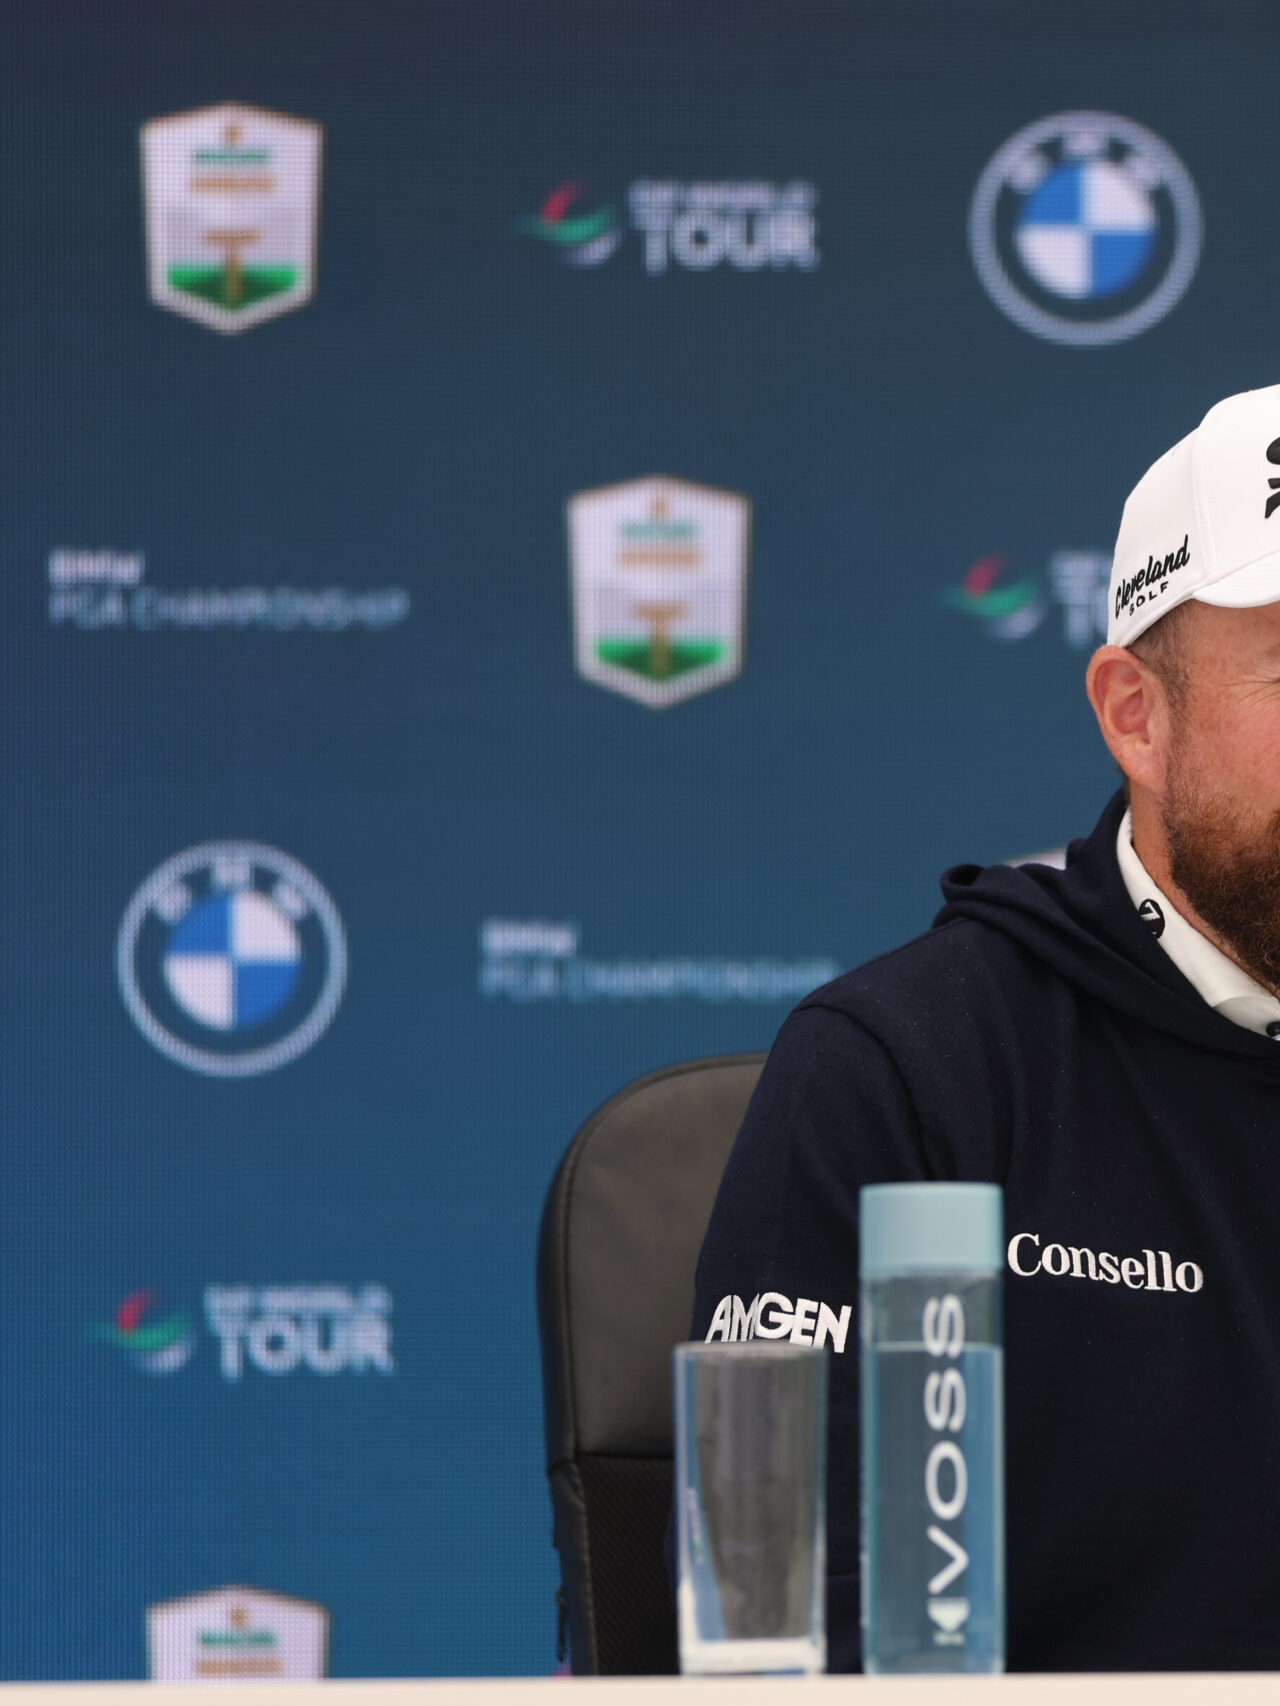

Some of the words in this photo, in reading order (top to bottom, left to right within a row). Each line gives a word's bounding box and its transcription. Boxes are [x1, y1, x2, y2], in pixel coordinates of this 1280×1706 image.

[634, 207, 819, 275] TOUR
[1115, 533, 1190, 620] Cleveland
[1129, 581, 1169, 616] GOLF
[1006, 1233, 1204, 1294] Consello
[209, 1311, 395, 1381] TOUR
[704, 1291, 852, 1354] AMGEN
[922, 1293, 970, 1595] VOSS
